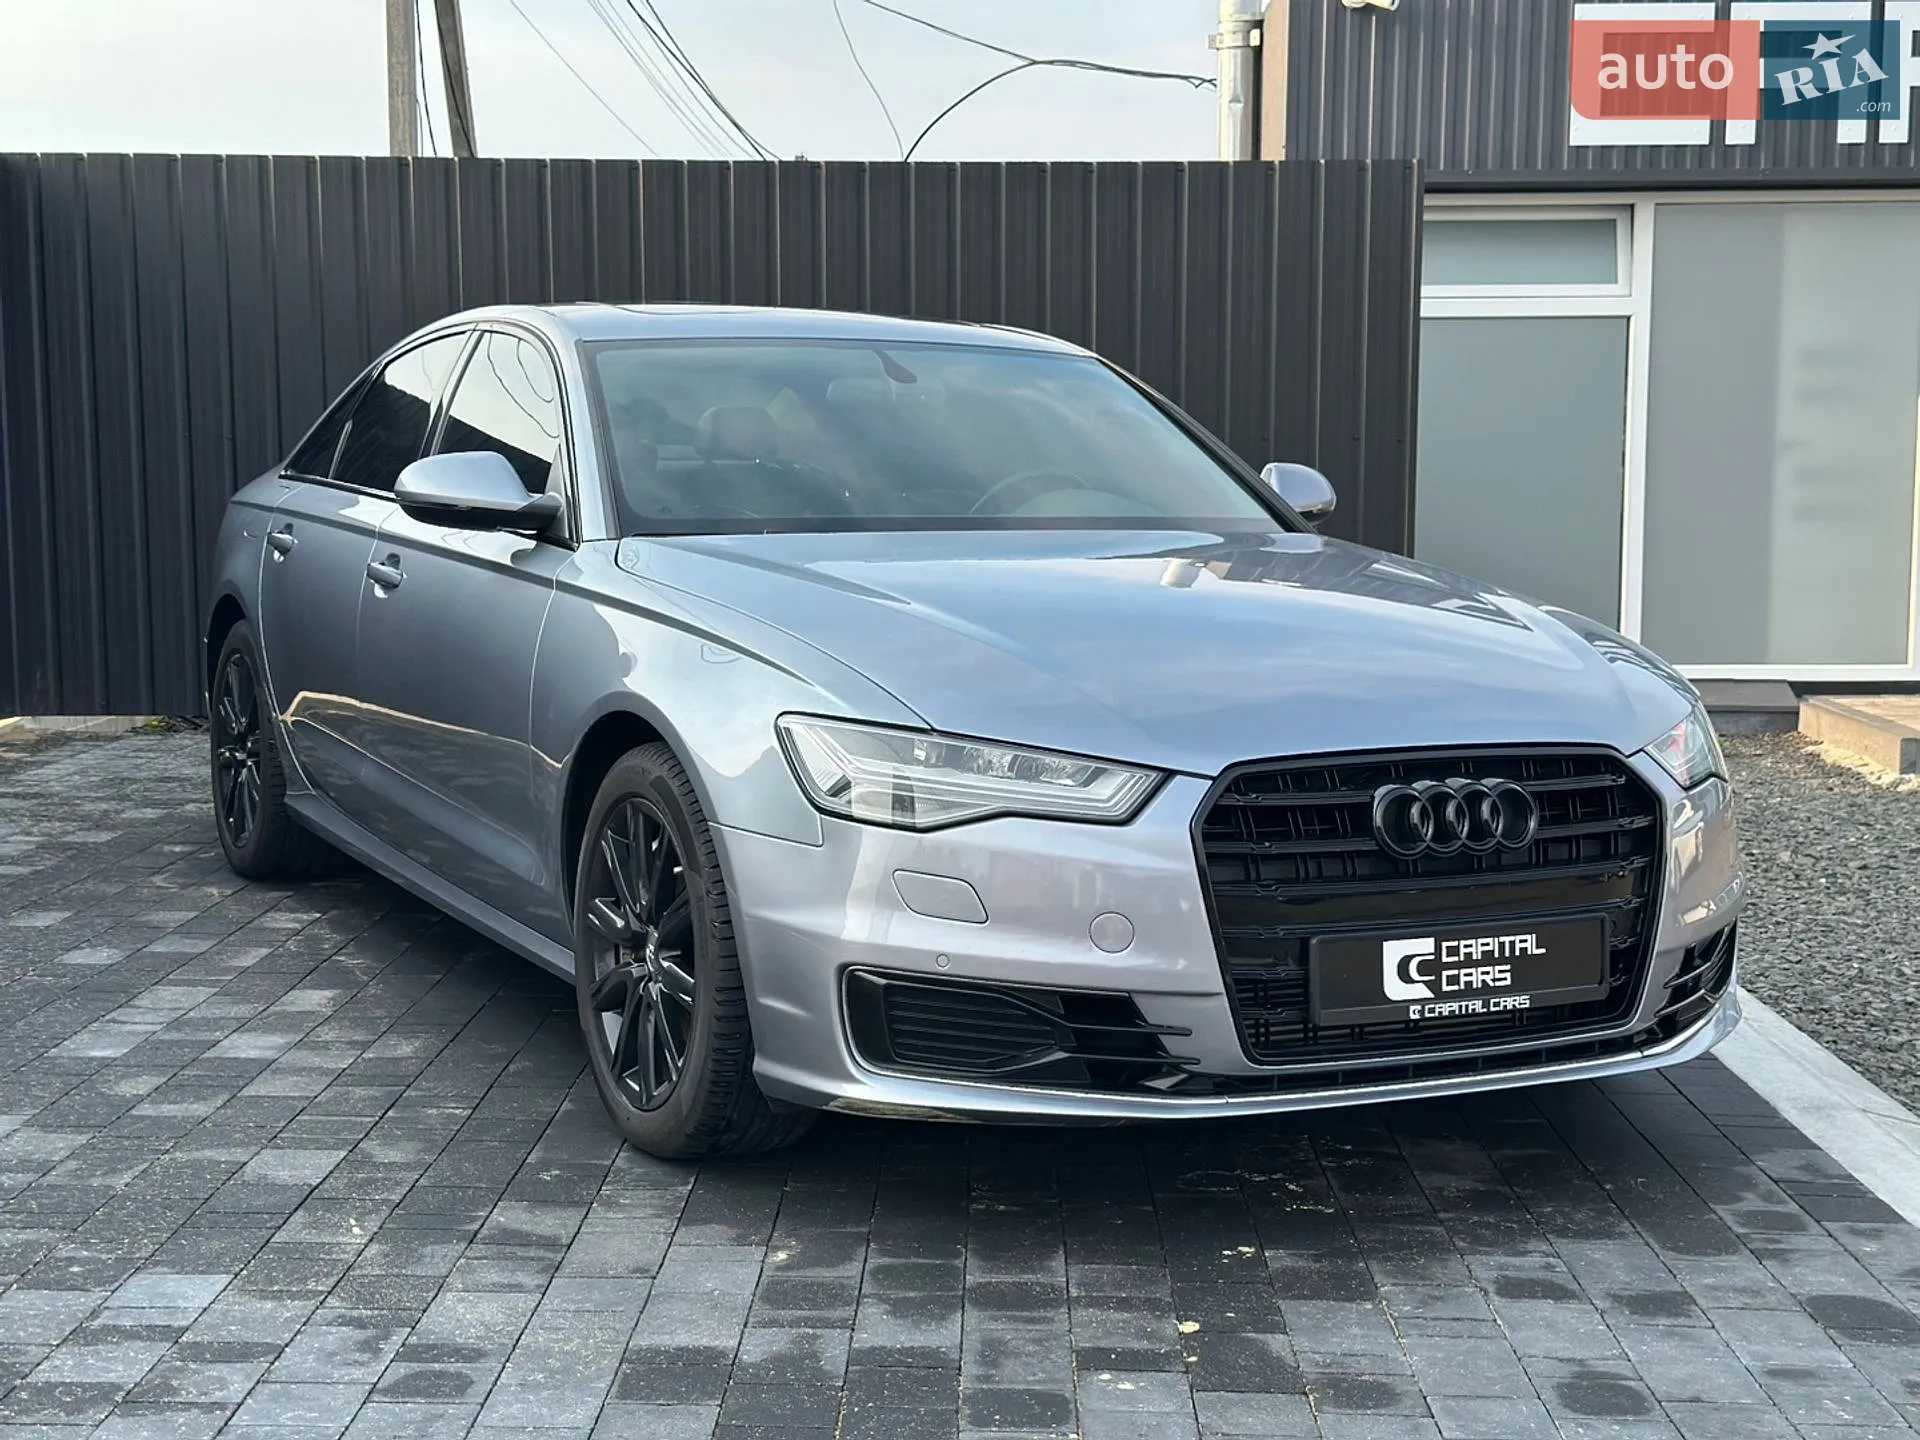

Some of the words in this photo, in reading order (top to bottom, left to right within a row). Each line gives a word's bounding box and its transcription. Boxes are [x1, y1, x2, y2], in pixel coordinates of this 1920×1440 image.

[1441, 933, 1546, 963] CAPITAL
[1441, 964, 1511, 992] CARS
[1425, 998, 1488, 1018] CAPITAL
[1490, 995, 1531, 1011] CARS
